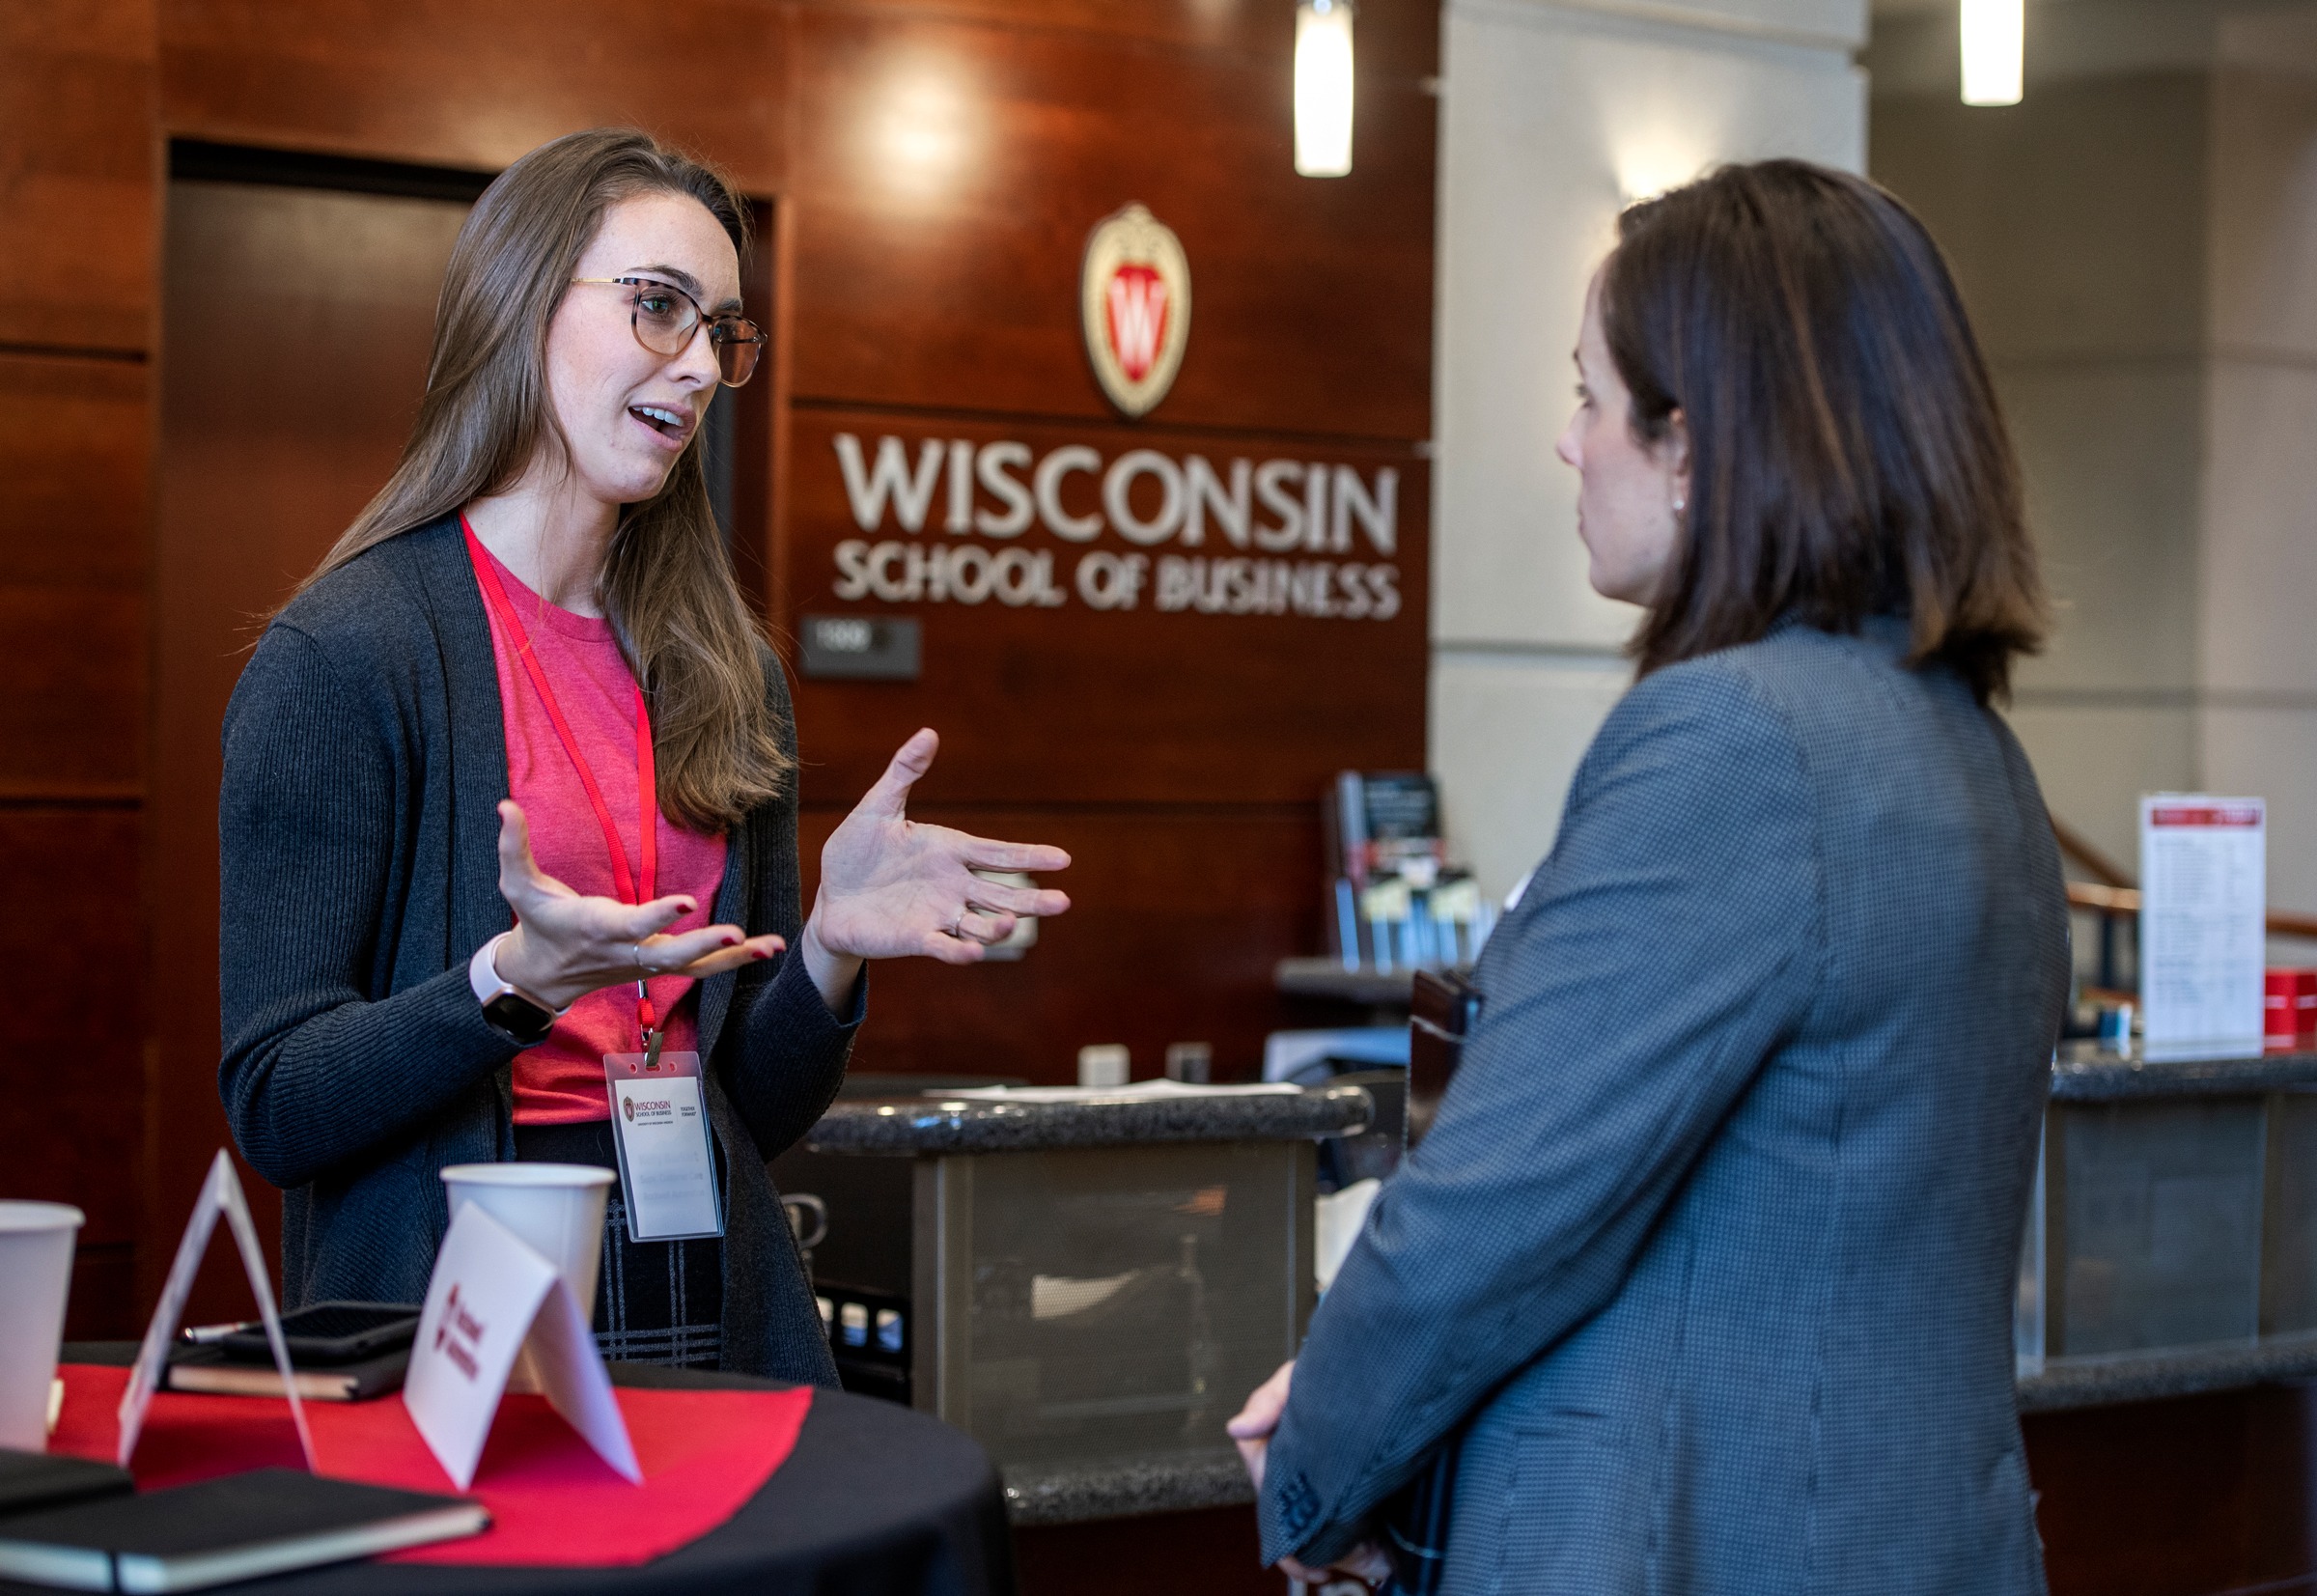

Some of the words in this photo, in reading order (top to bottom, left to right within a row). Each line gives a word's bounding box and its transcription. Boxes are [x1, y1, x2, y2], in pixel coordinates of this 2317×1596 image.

[1106, 273, 1167, 366] W
[832, 432, 1400, 555] WISCONSIN
[832, 539, 1065, 607] SCHOOL
[1075, 550, 1150, 611] OF
[1155, 554, 1402, 620] BUSINESS
[634, 1101, 671, 1110] WISCONSIN
